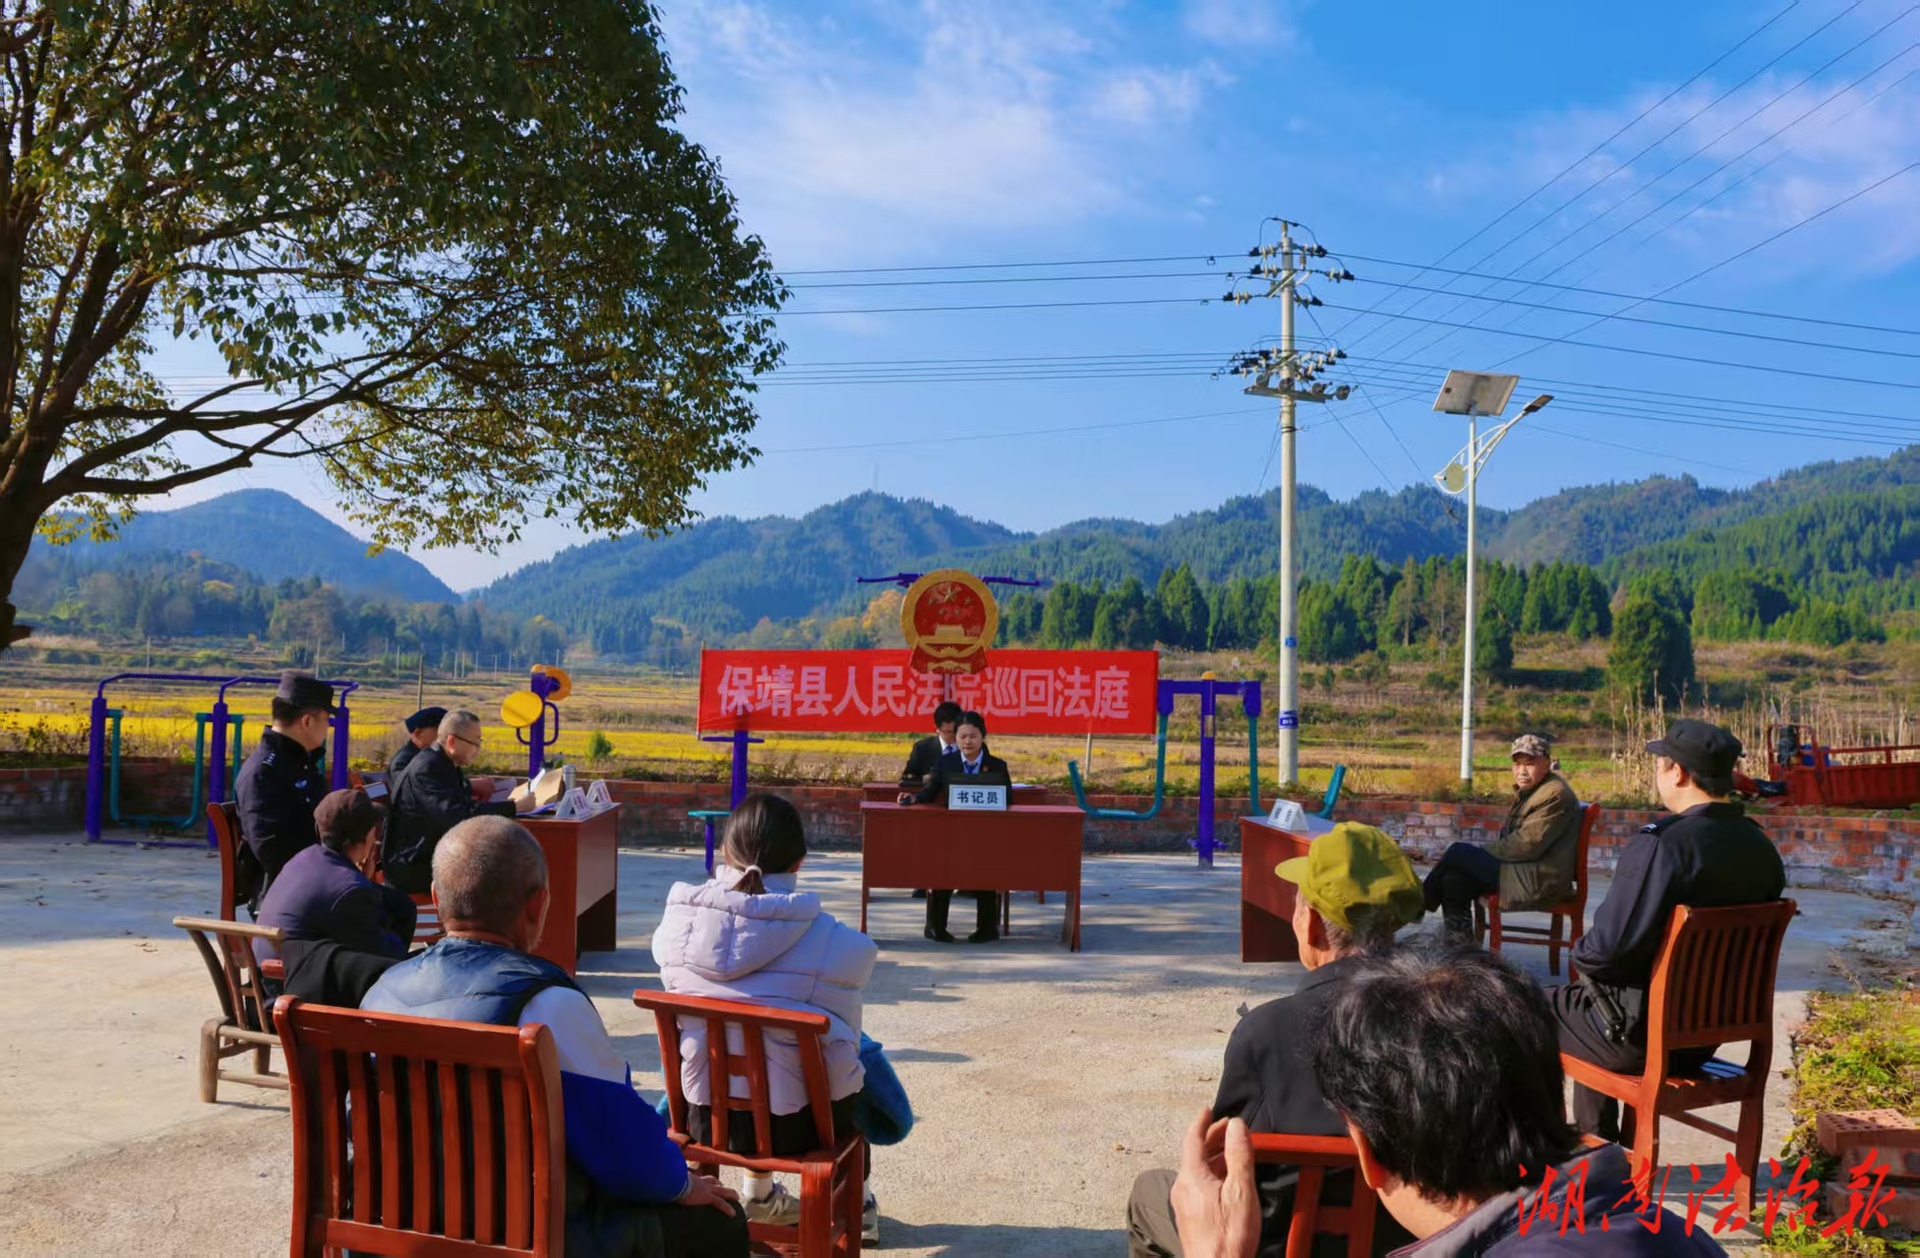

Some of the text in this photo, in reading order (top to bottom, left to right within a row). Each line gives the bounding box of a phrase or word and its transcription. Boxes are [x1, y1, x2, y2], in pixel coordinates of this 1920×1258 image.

[717, 664, 1130, 719] 保靖县人民法院巡回法庭
[957, 790, 998, 804] 书记员
